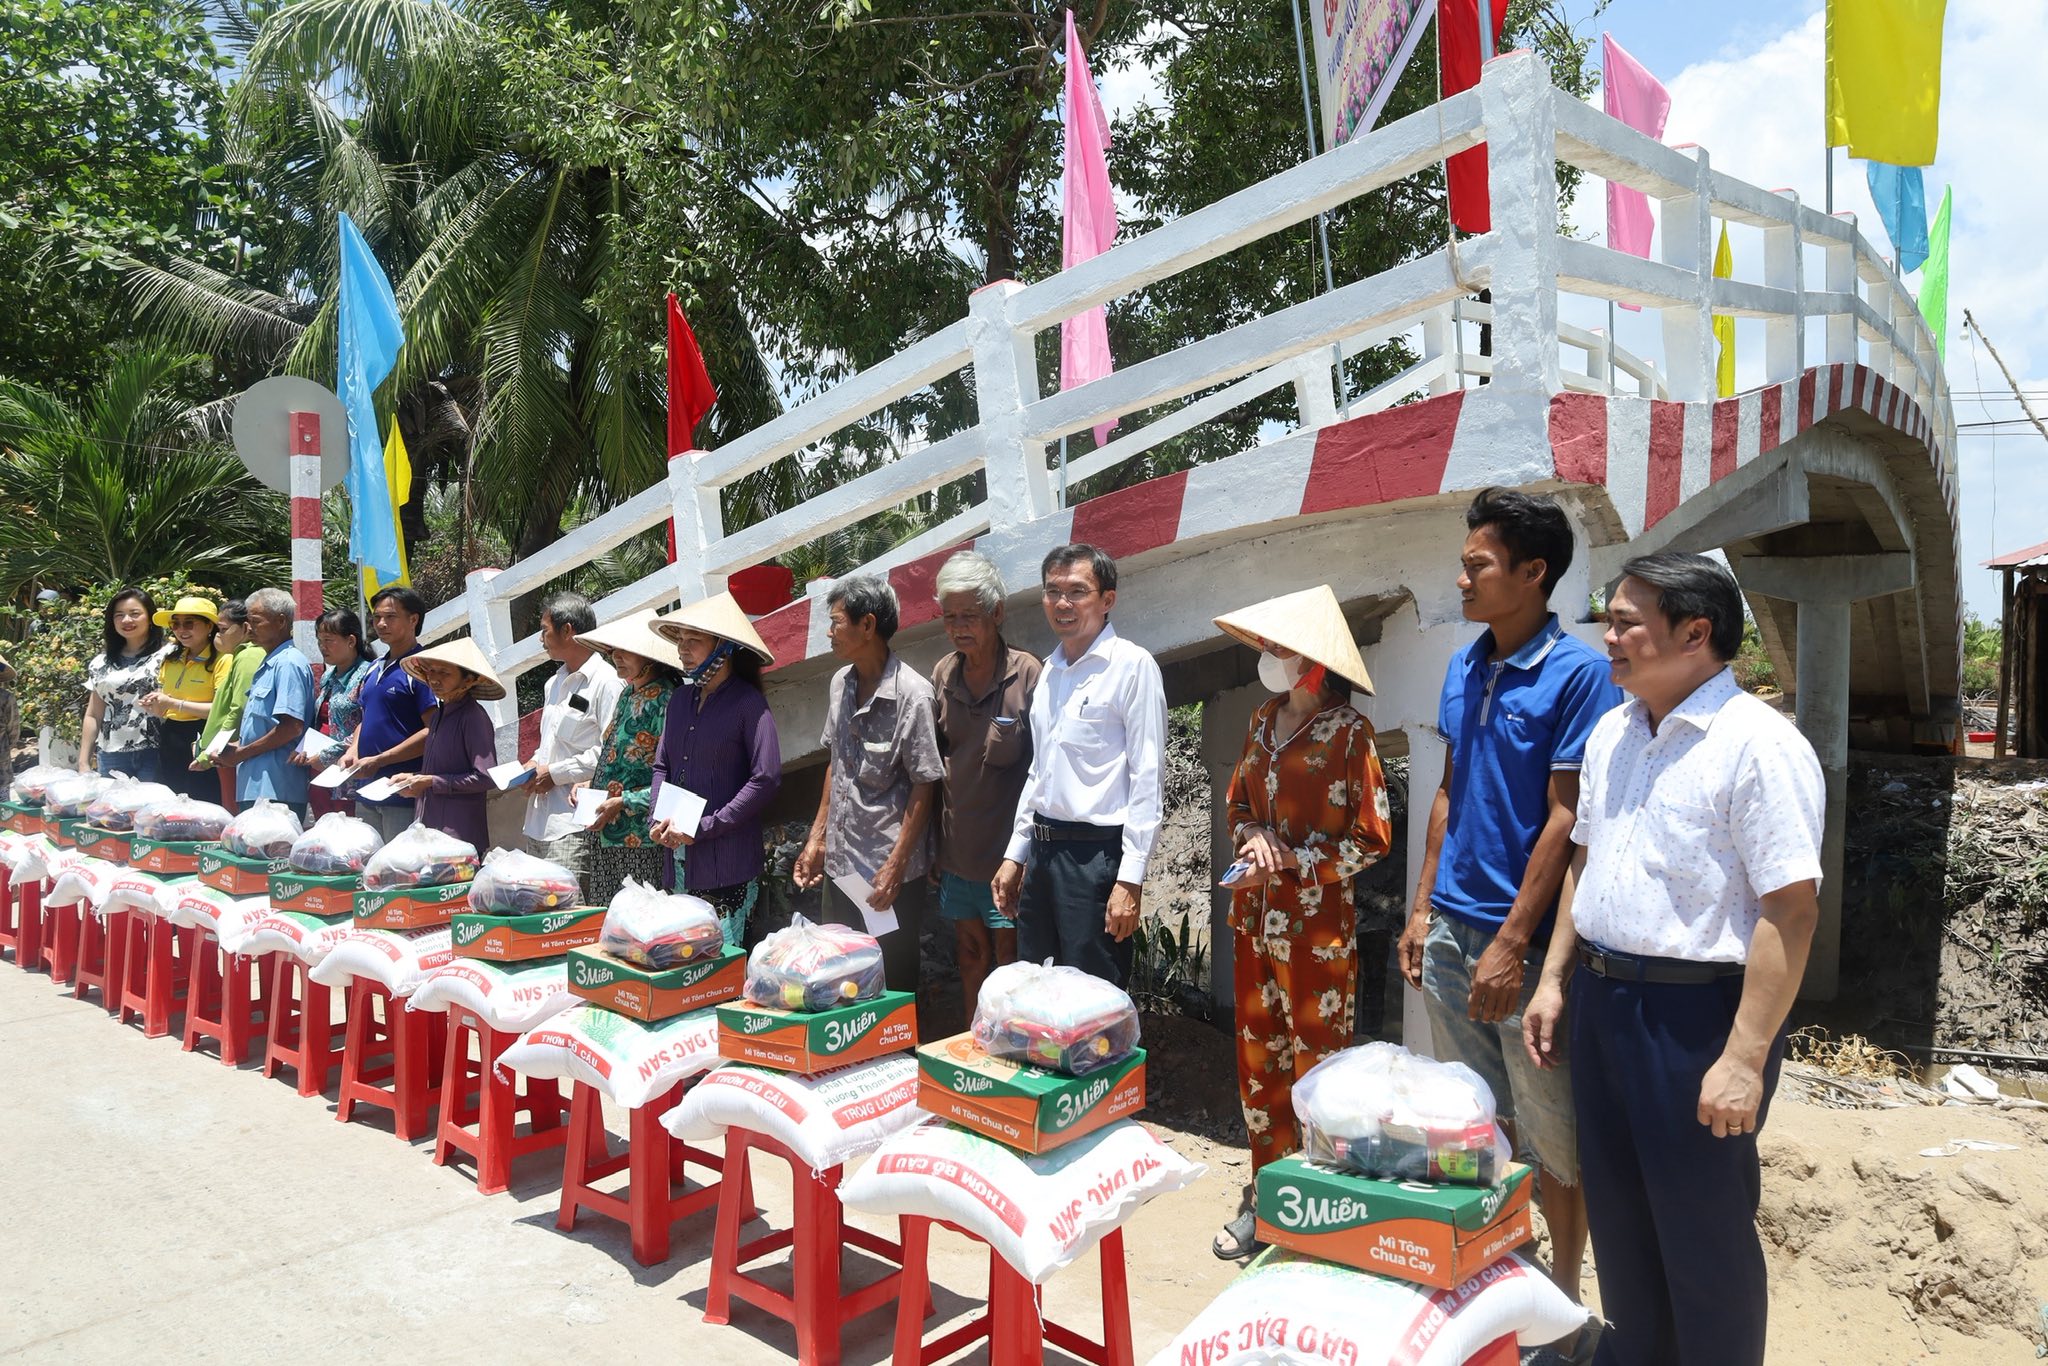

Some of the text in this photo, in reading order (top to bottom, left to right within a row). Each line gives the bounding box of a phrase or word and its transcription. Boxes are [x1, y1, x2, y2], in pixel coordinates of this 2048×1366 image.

[879, 1031, 913, 1046] Chua Cay
[893, 1022, 909, 1035] Tôm
[783, 1054, 797, 1066] Cay
[1124, 1085, 1139, 1099] Tôm
[1108, 1094, 1141, 1116] Chua Cay
[951, 1104, 1021, 1140] Mì Tôm Chua Cay
[1276, 1185, 1369, 1229] 3Miền
[1378, 1234, 1430, 1258] Mì Tôm
[1369, 1245, 1437, 1276] Chua Cay
